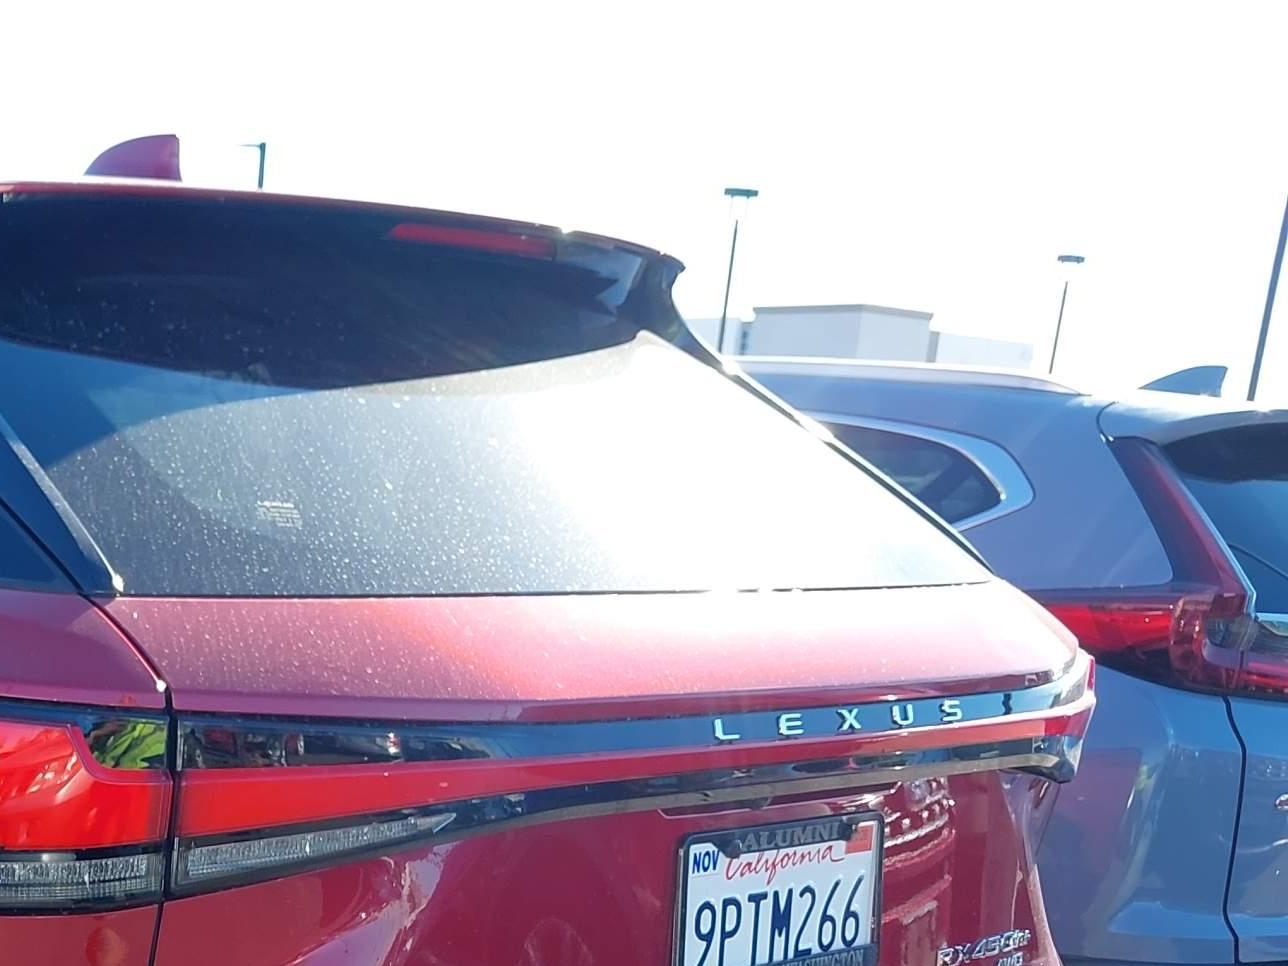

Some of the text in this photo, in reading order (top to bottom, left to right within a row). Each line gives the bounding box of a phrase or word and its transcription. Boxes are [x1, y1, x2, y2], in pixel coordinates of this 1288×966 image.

[714, 699, 964, 741] LEXUS
[743, 822, 841, 852] ALUMNI
[691, 850, 719, 874] NOV
[725, 844, 845, 886] California
